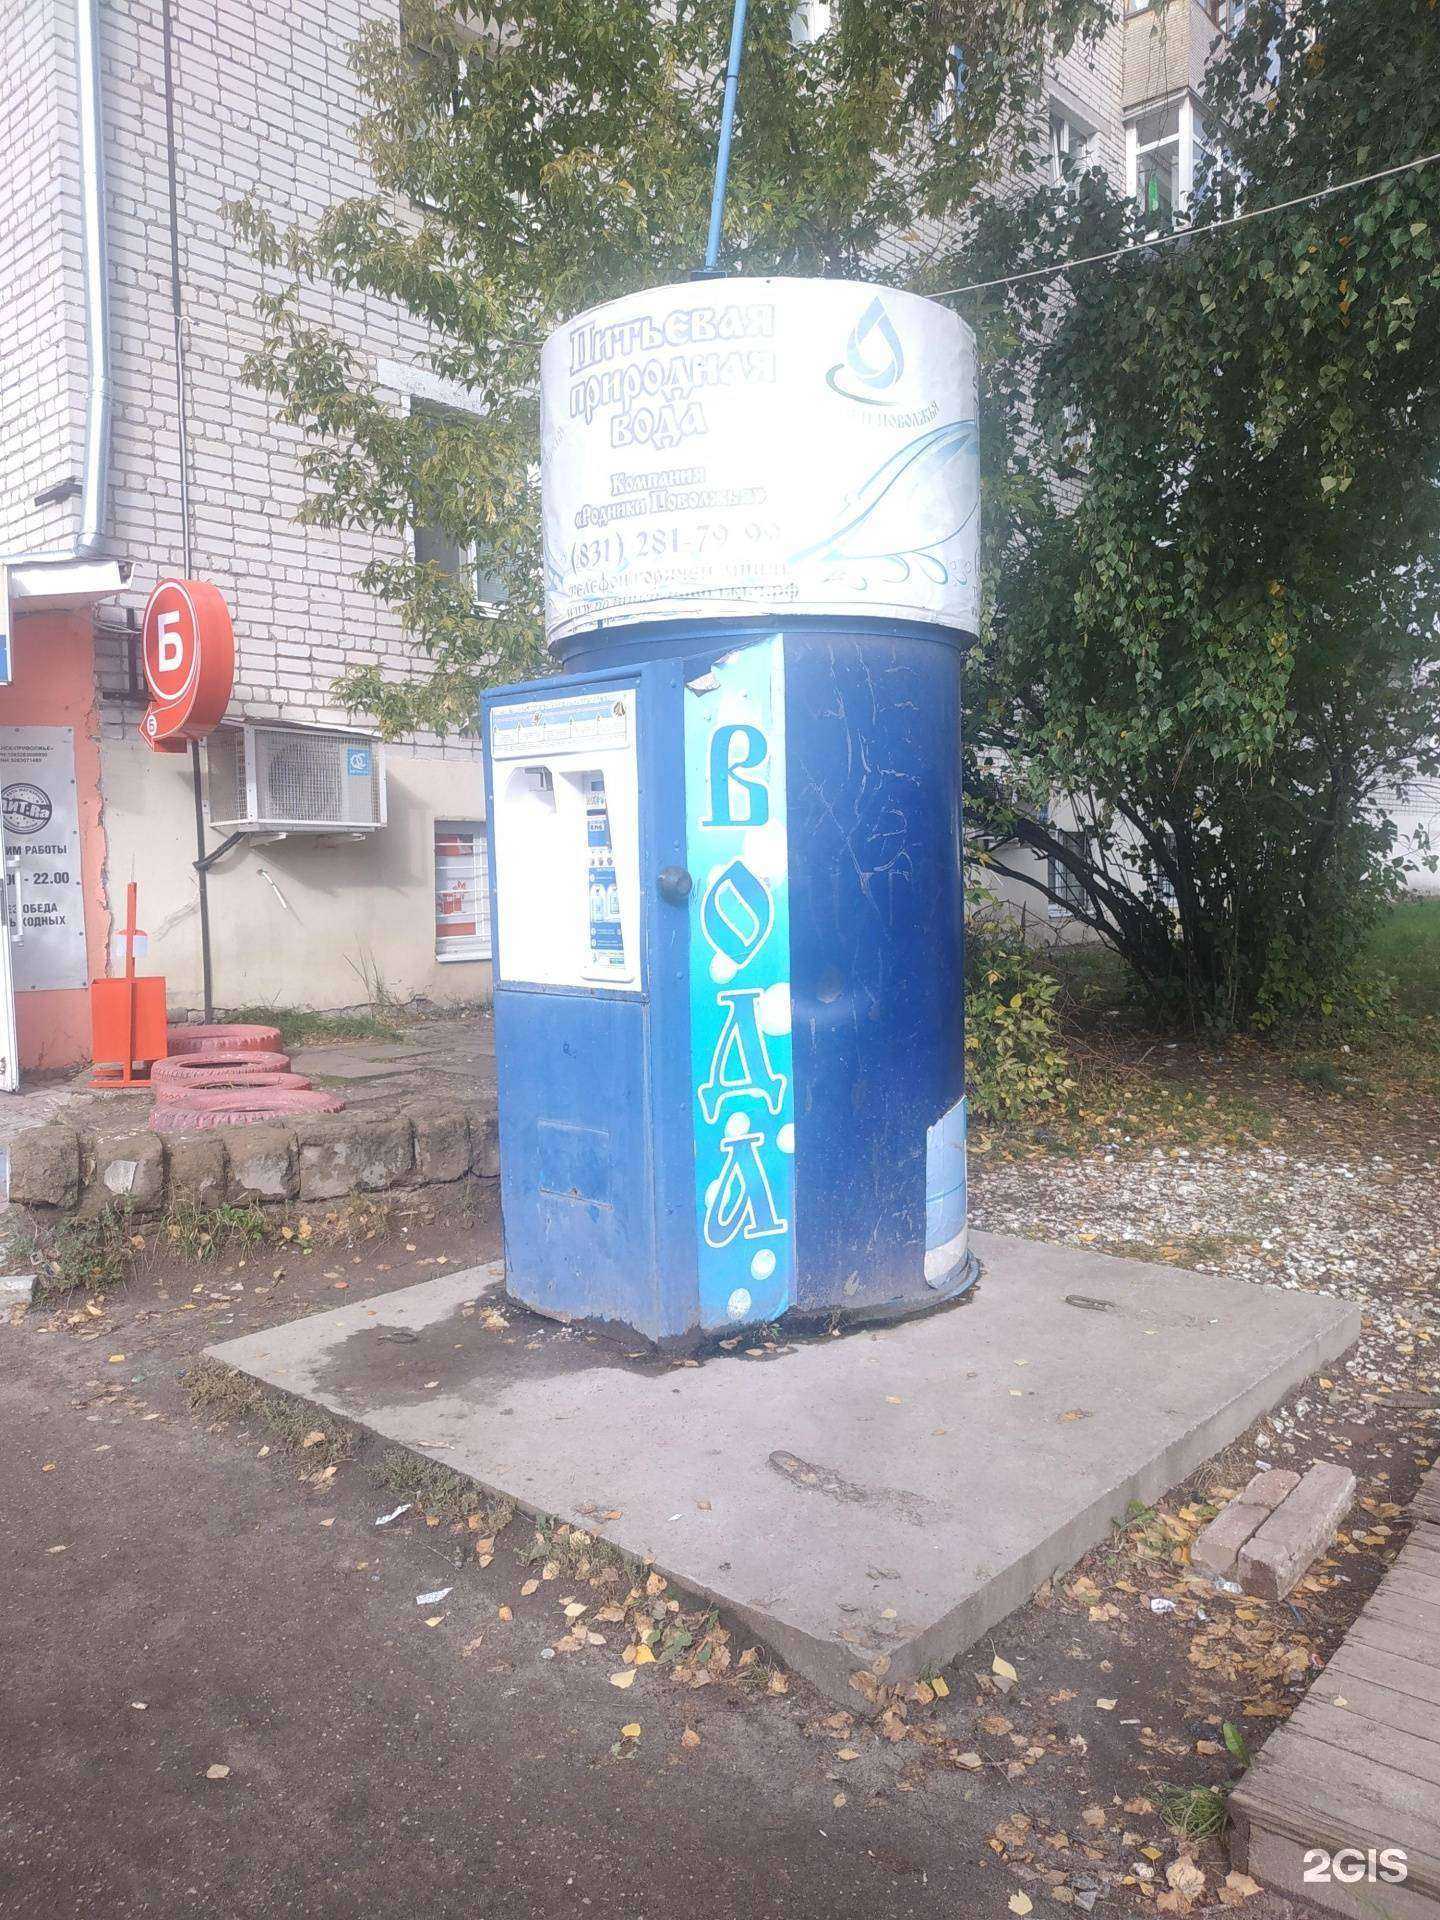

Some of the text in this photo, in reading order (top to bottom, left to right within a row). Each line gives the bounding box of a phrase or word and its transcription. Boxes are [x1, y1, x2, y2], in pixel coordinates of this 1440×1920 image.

[571, 531, 624, 575] (831)
[157, 610, 184, 673] Б
[25, 845, 68, 855] РАБОТЫ
[33, 872, 70, 885] 22.00
[23, 903, 58, 914] ОБЕДА
[698, 722, 788, 1248] ВОДА
